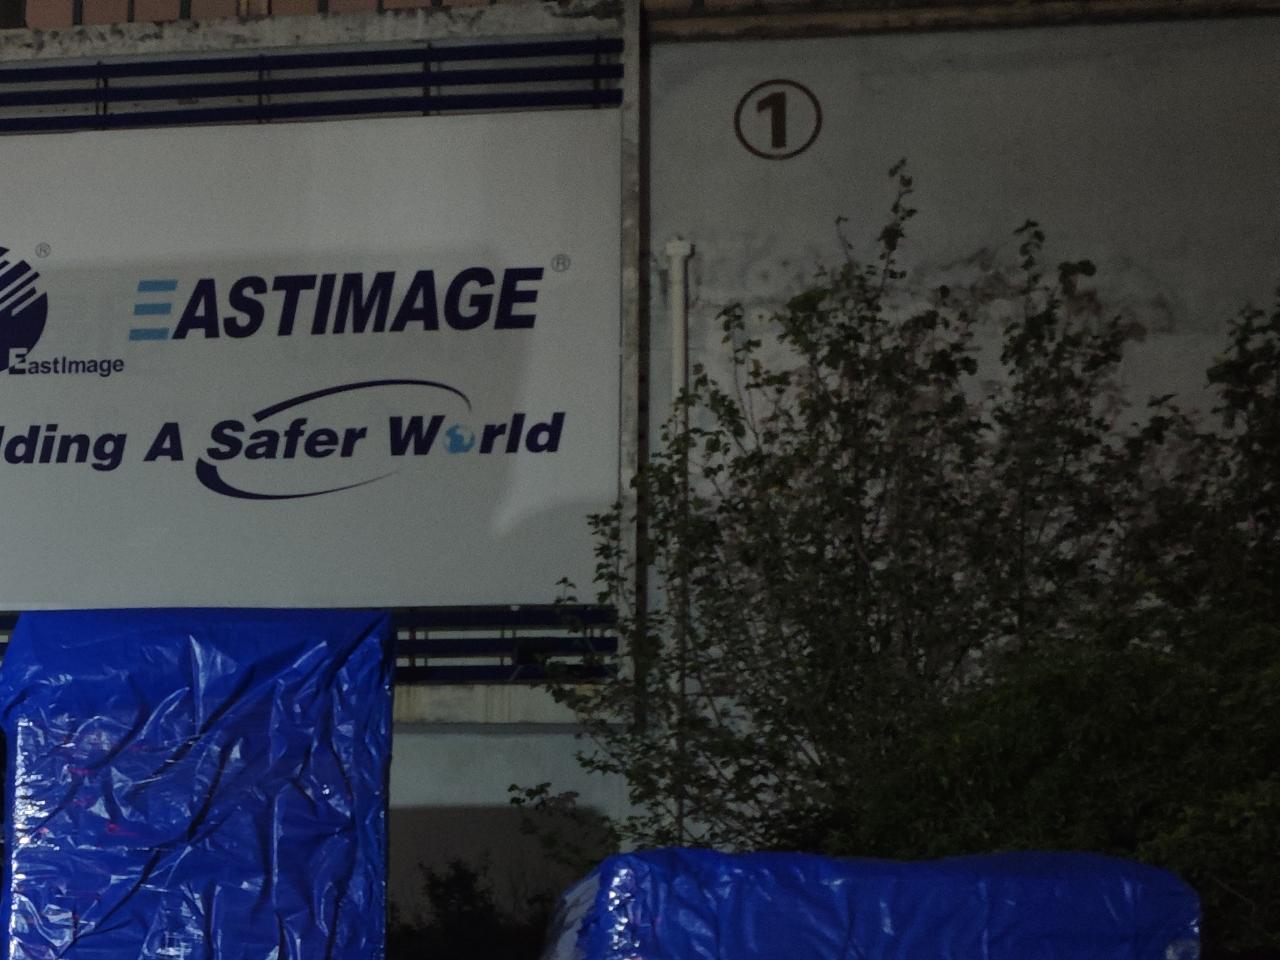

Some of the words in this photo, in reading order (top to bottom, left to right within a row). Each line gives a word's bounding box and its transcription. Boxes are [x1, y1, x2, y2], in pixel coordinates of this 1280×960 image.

[128, 266, 545, 342] EASTIMAGE
[8, 348, 125, 378] EastImage
[143, 421, 185, 462] A
[206, 417, 368, 460] Safer
[388, 411, 566, 456] World
